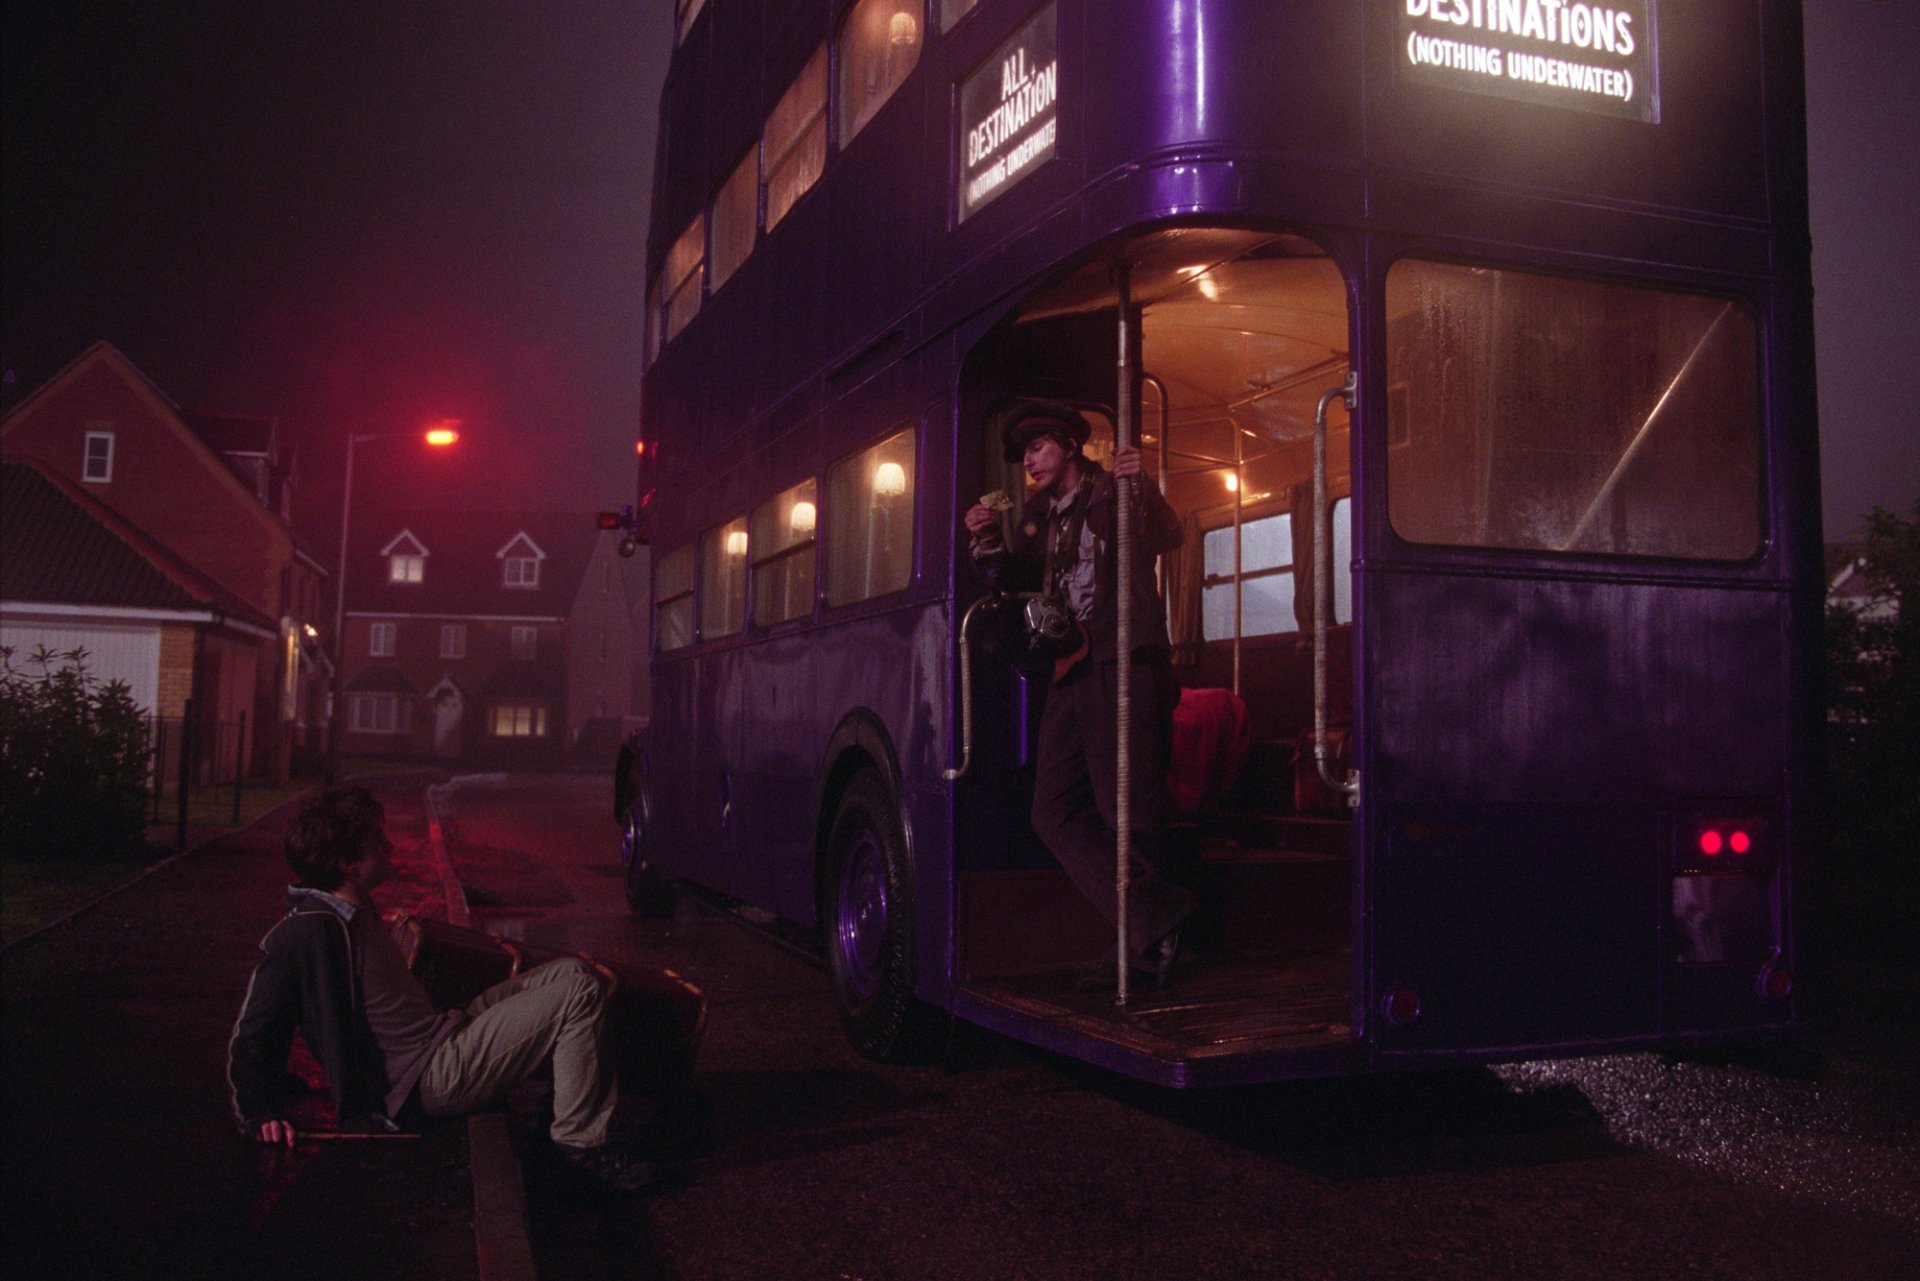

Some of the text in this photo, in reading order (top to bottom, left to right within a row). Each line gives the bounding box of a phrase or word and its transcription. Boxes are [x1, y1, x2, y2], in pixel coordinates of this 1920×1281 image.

[1002, 48, 1027, 101] ALL
[1407, 31, 1634, 102] (NOTHING UNDERWATER)
